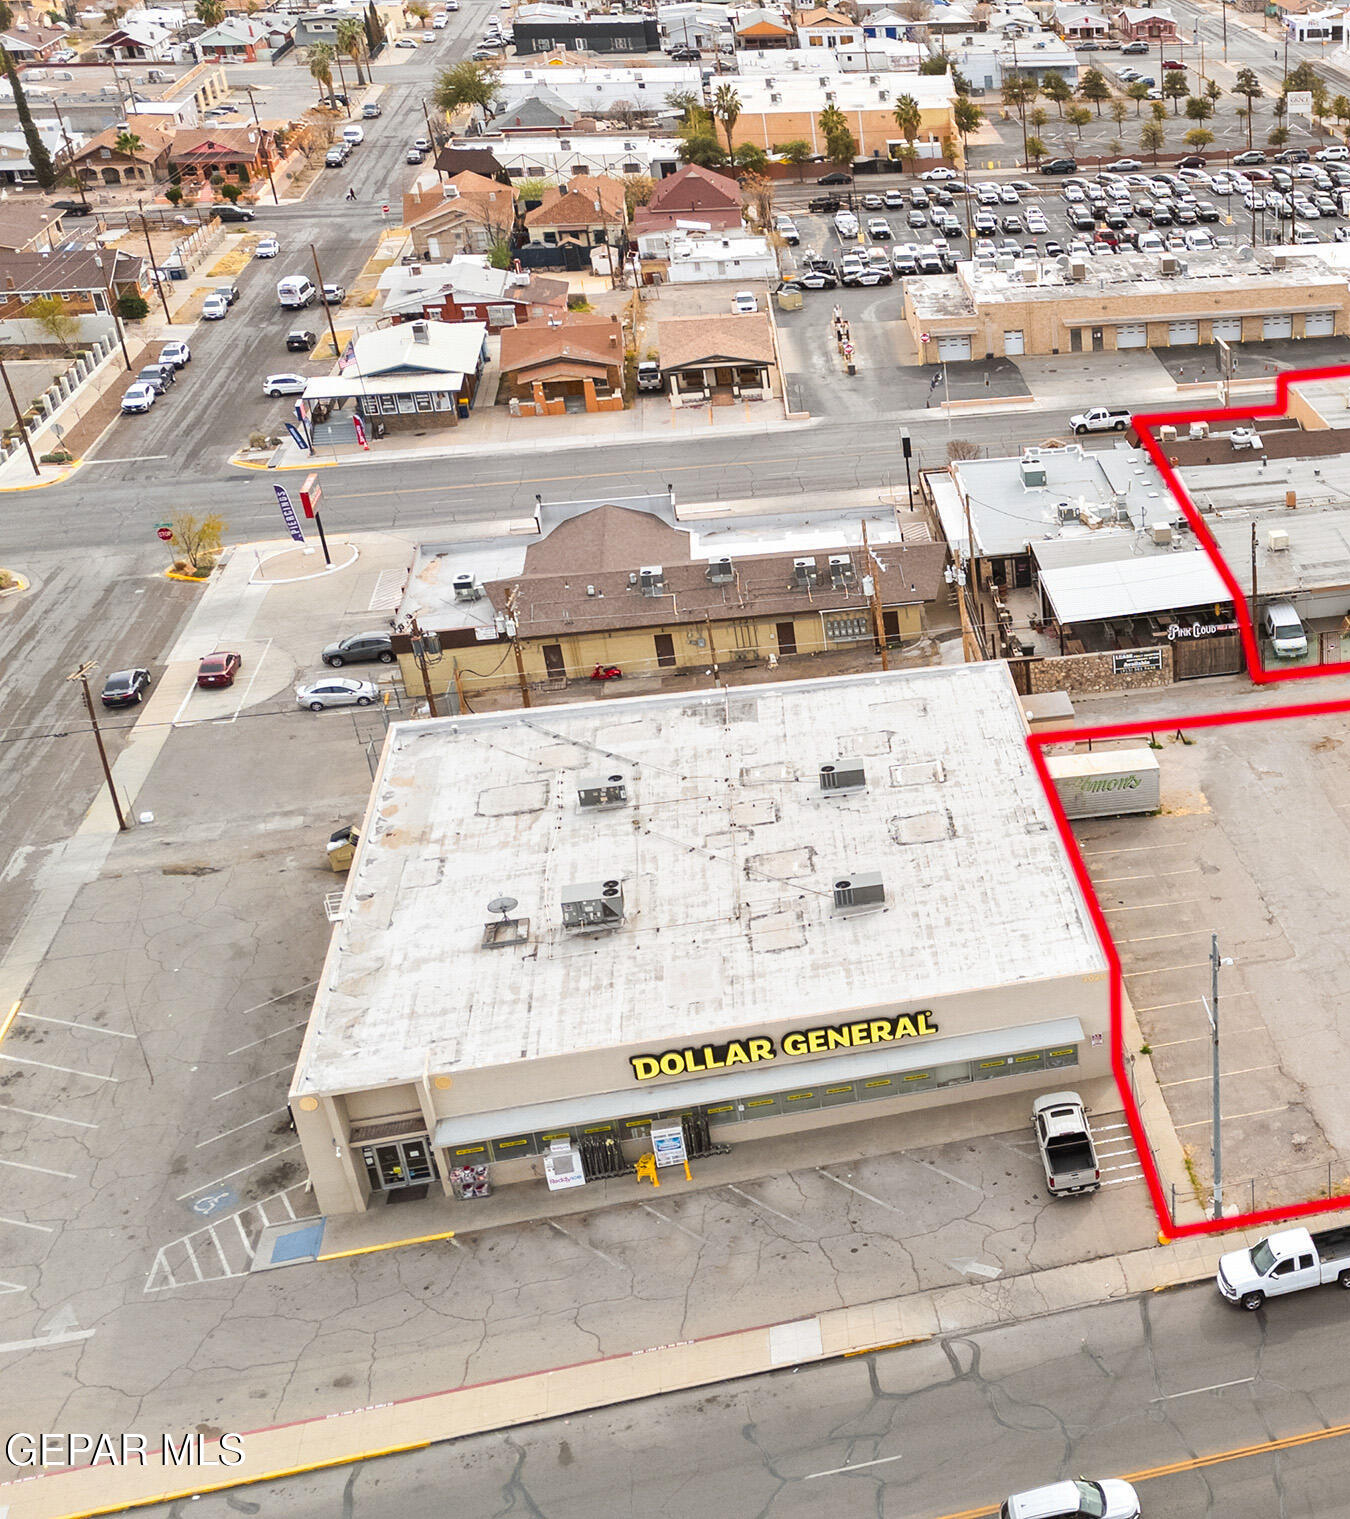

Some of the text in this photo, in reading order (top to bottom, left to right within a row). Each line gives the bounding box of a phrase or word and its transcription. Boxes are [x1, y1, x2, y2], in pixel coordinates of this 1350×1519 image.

[277, 491, 300, 534] PIERCINGS
[1193, 622, 1217, 637] CLOUD
[632, 1013, 937, 1081] DOLLAR GENERAL
